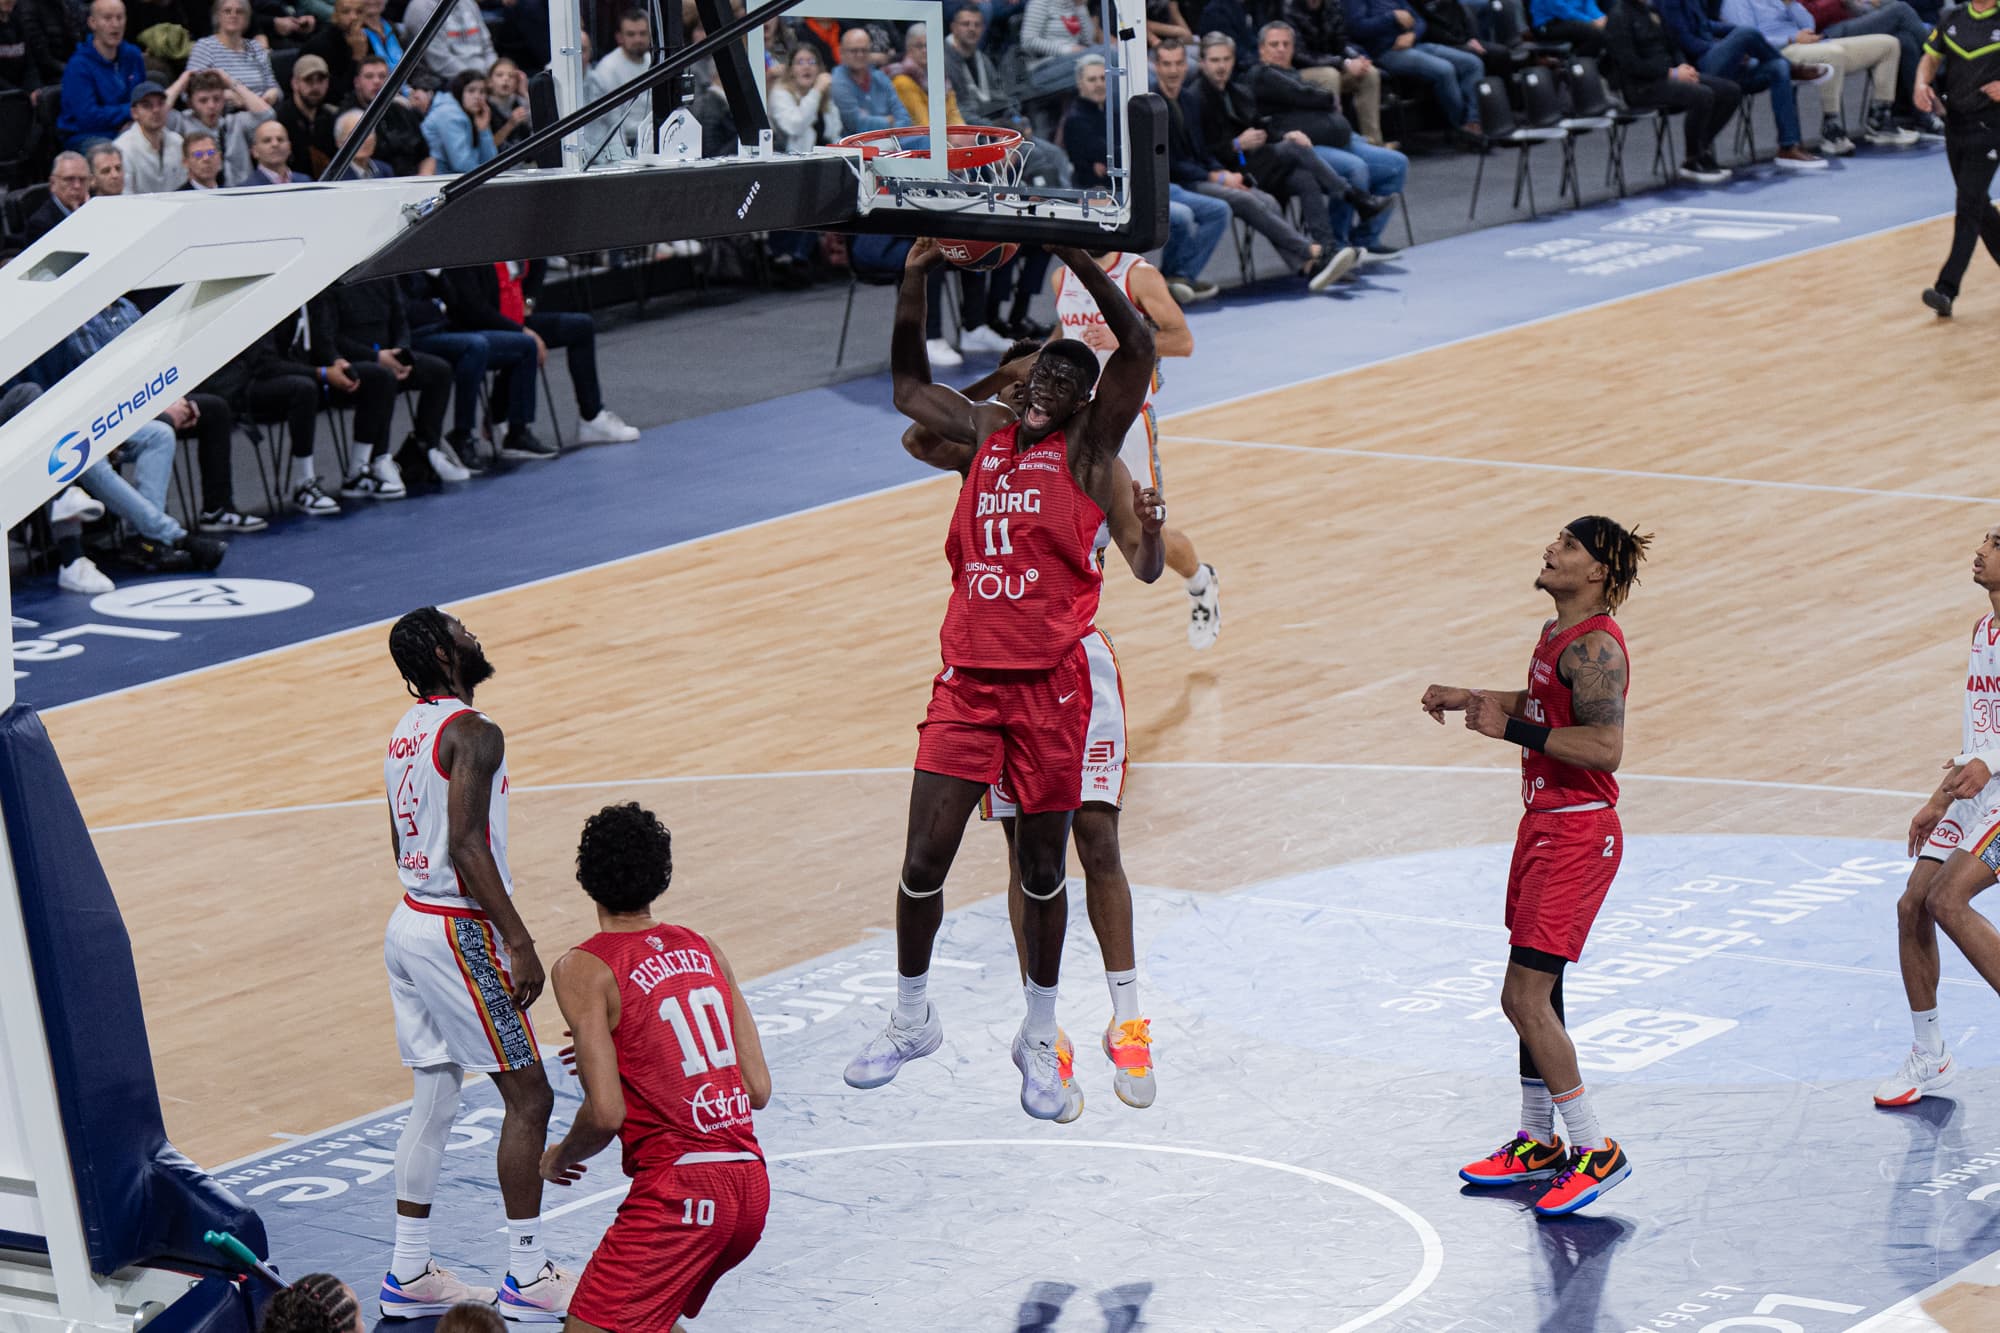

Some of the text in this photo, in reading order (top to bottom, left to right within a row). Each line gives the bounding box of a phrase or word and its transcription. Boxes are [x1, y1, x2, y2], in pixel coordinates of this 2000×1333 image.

[91, 366, 179, 441] Schelde
[976, 488, 1040, 517] BOURG
[983, 518, 1013, 556] 11
[966, 573, 1025, 600] YOU
[1602, 835, 1615, 857] 2
[629, 948, 715, 996] RISACHER
[658, 985, 737, 1079] 10
[681, 1198, 716, 1226] 10
[1698, 1285, 1745, 1301] LE
